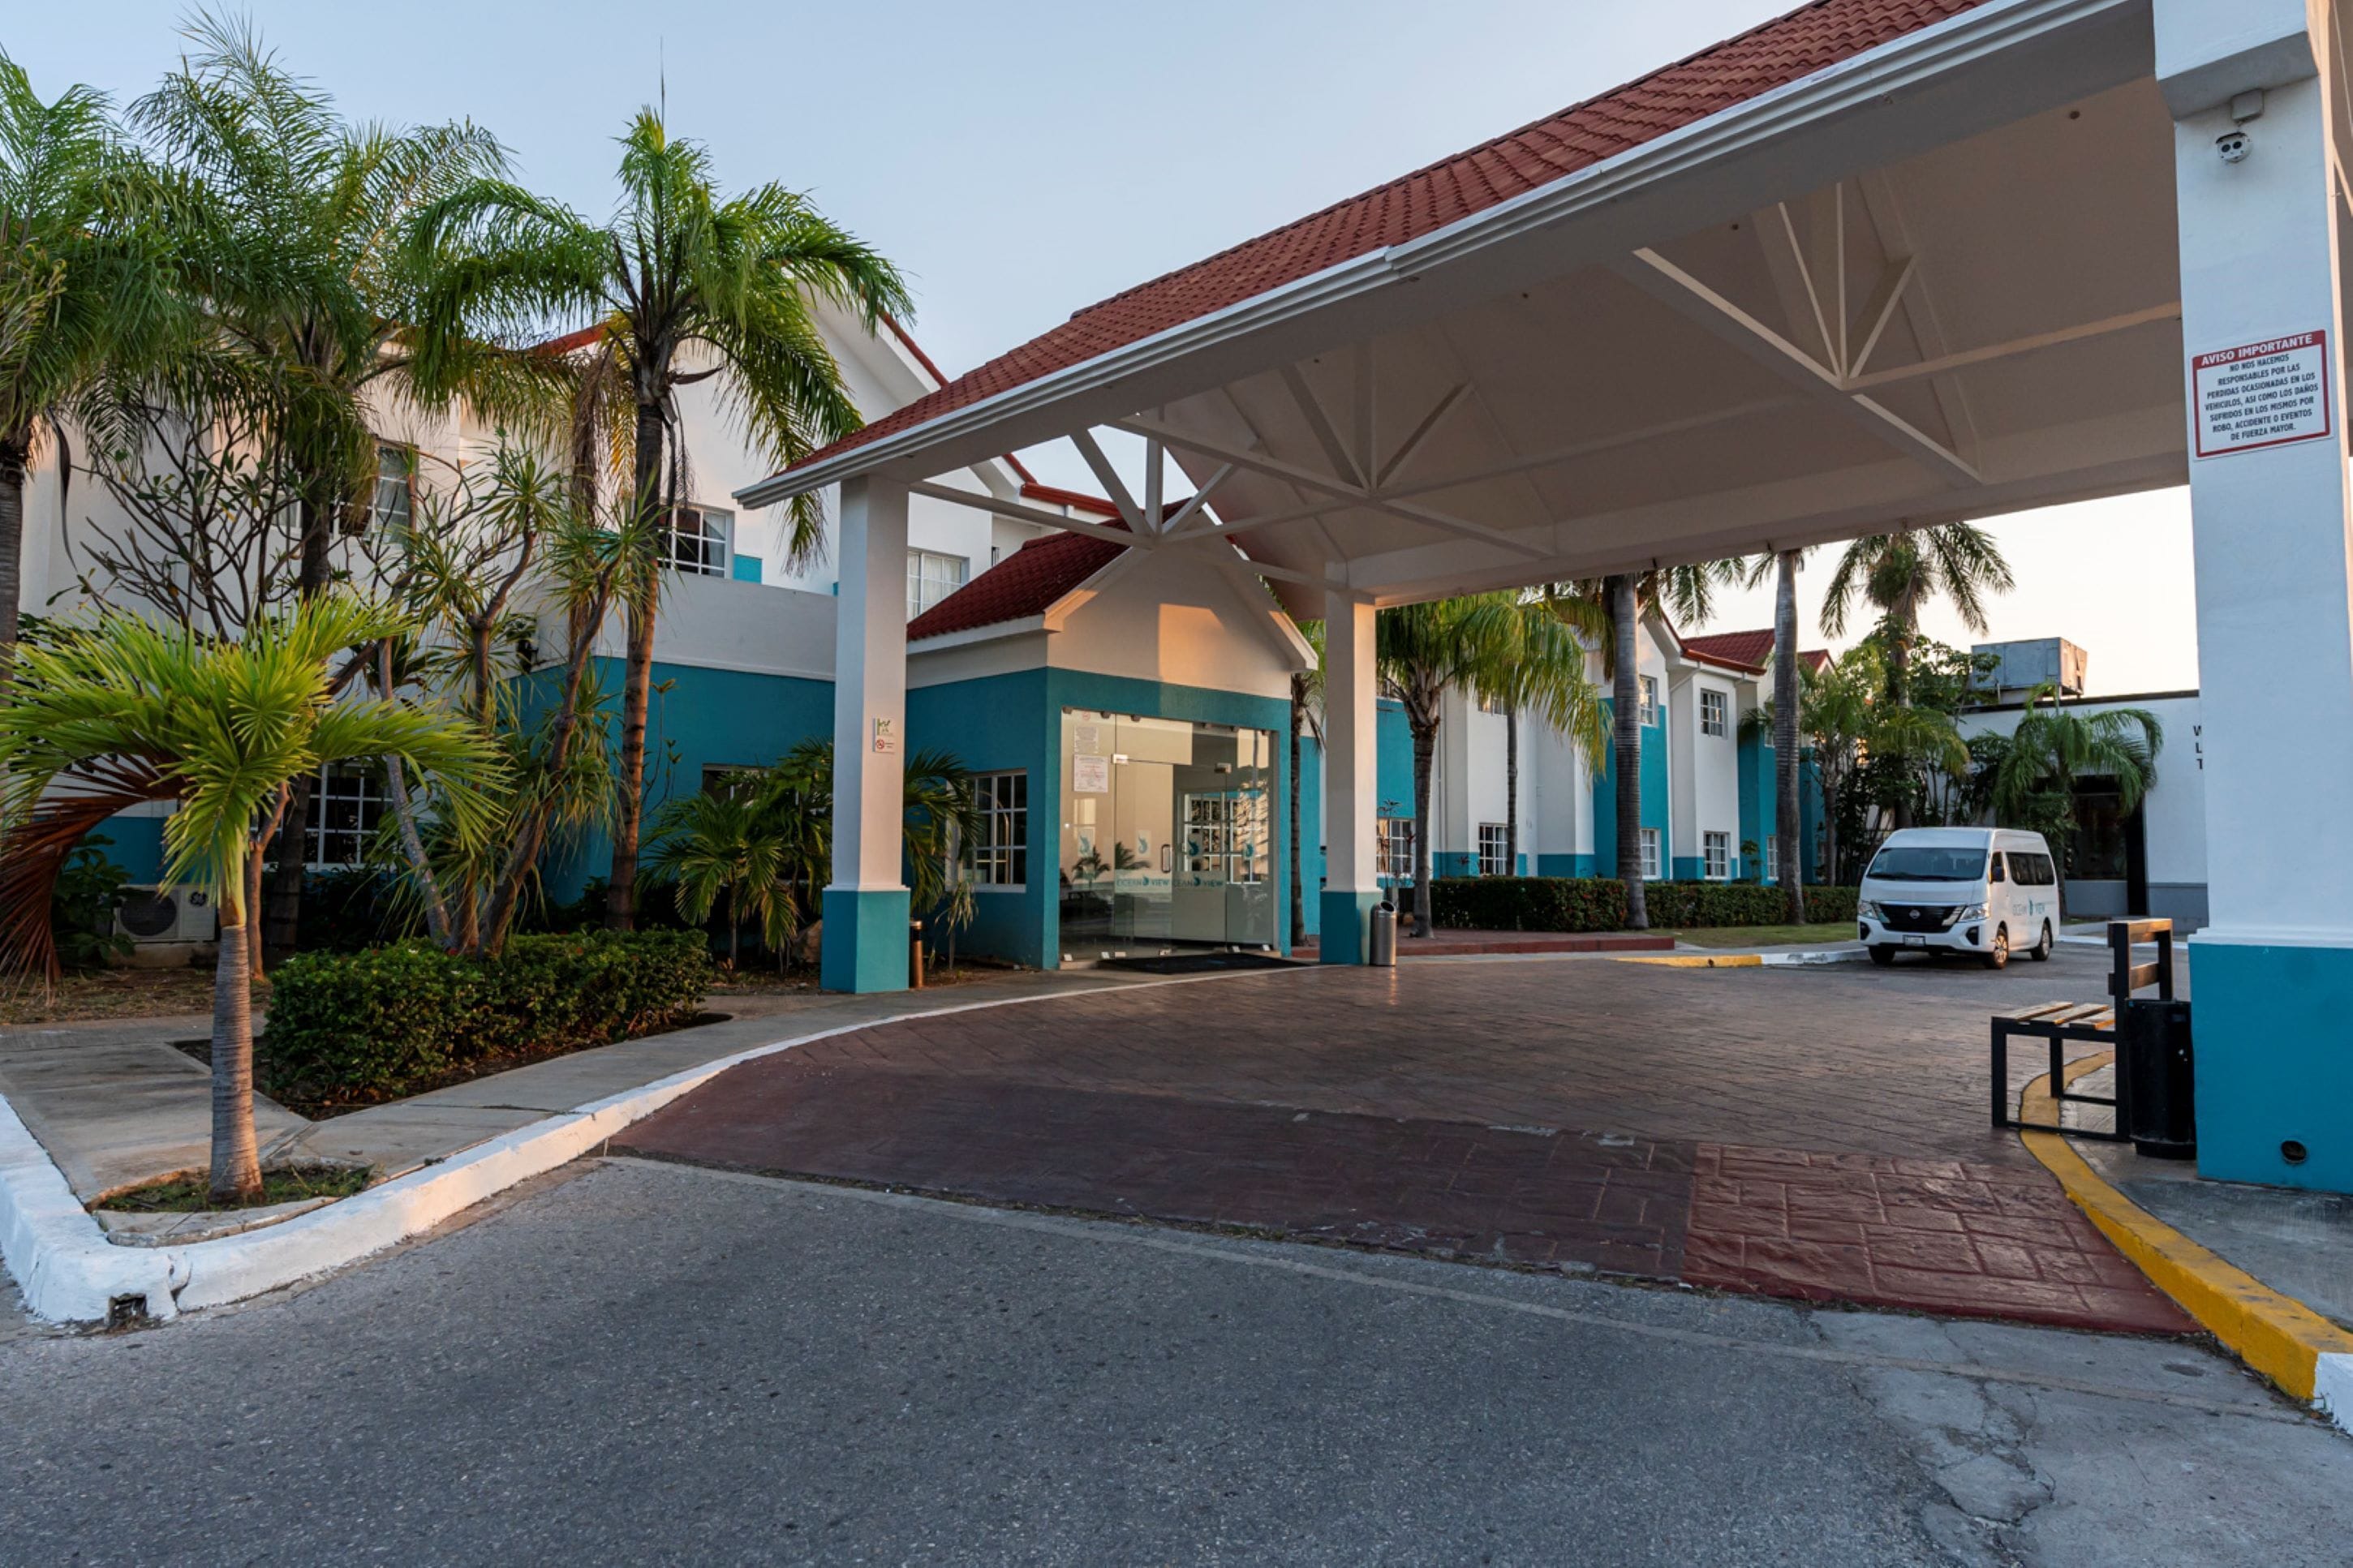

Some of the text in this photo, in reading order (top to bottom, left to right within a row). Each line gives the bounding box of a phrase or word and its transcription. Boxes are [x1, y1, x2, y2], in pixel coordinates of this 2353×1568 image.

[2201, 334, 2312, 366] AVISO IMPORTANTE
[2217, 363, 2300, 386] RESPONSABLES POR LAS
[2230, 354, 2290, 372] NO NOS HACEMOS
[2207, 372, 2316, 399] PERDIDAS OCASIONADAS EN LOS
[2245, 395, 2256, 403] ASI
[2258, 391, 2278, 402] COMO
[2279, 388, 2292, 397] LOS
[2295, 383, 2319, 395] DAÑOS
[2209, 396, 2314, 422] SUFRIDOS EN LOS MISMOS POR
[2213, 409, 2312, 433] ROBO, ACCIDENTE O EVENTOS
[2230, 423, 2295, 440] DE FUERZA MAYOR.
